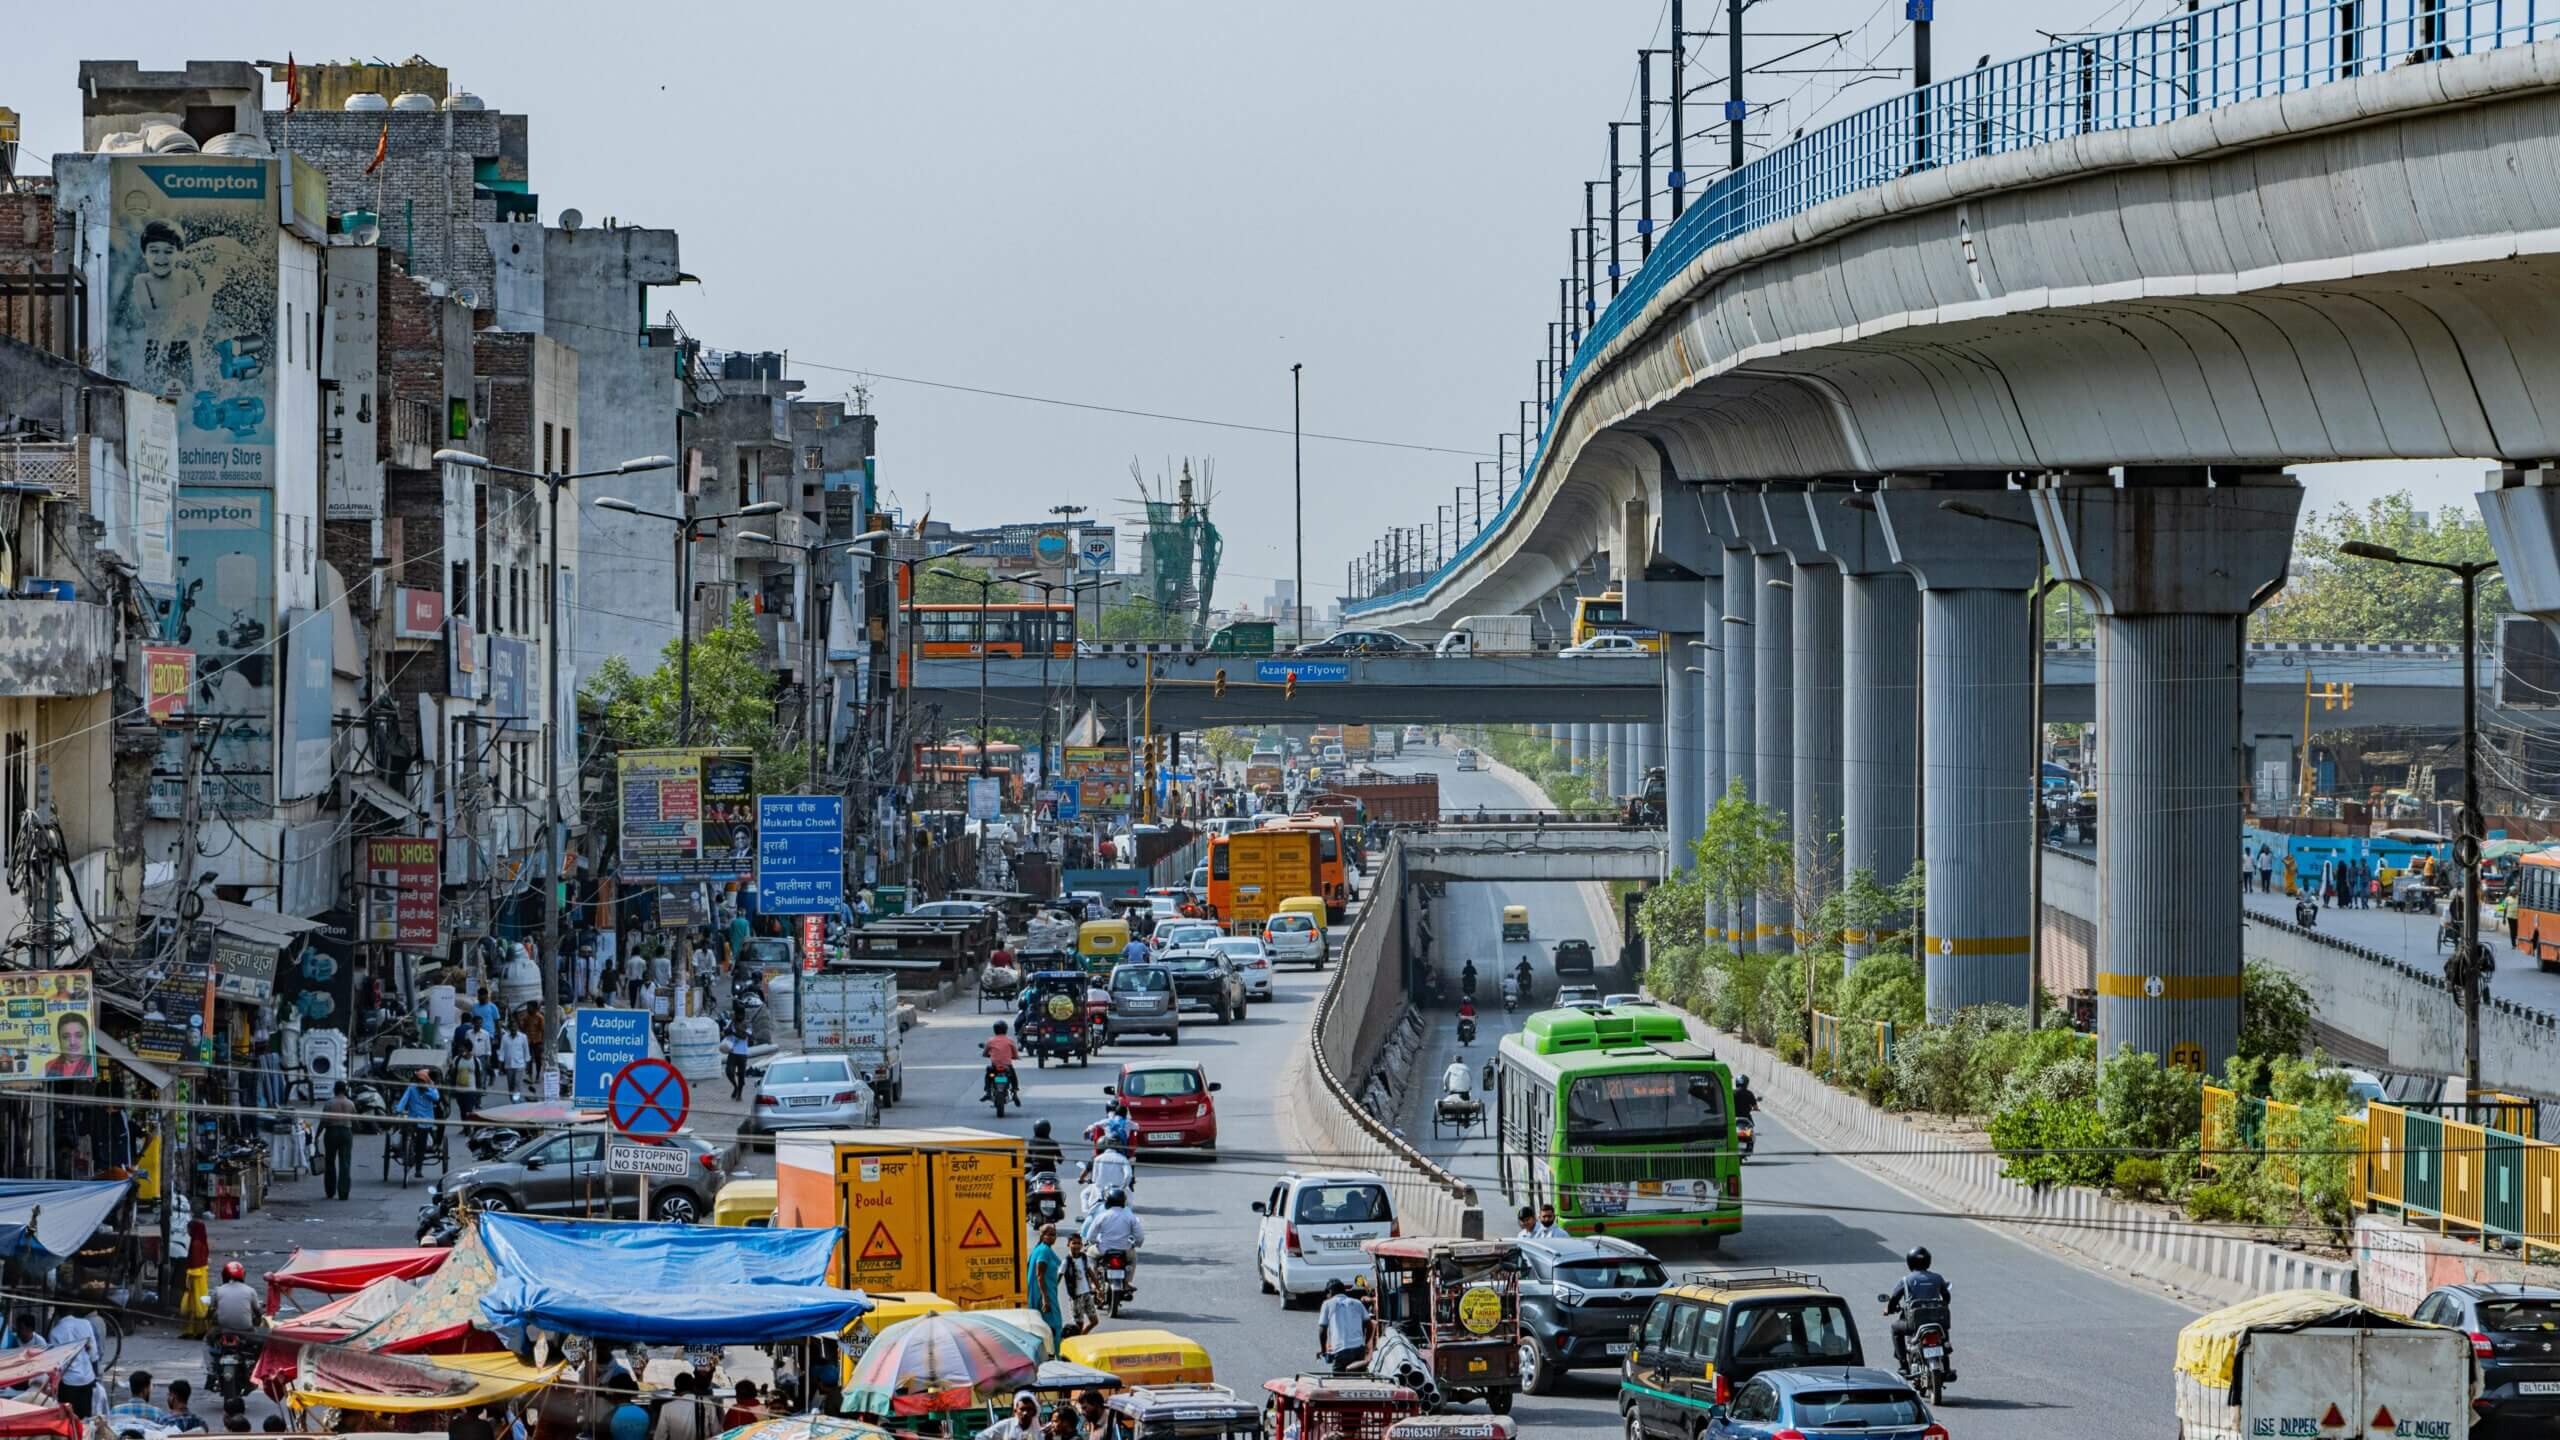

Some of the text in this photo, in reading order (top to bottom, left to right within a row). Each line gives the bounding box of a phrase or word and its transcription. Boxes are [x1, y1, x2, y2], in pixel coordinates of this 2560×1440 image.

[163, 174, 258, 192] Crompton
[232, 448, 262, 465] Store
[328, 503, 374, 511] AGGARWAL
[1090, 543, 1106, 553] HP
[1307, 665, 1346, 676] Flyover
[762, 818, 837, 827] Mukarba Chowk
[371, 844, 434, 864] TONI SHOES
[762, 856, 796, 865] Burari
[775, 895, 841, 906] Shalimar Bagh
[591, 1016, 637, 1030] Azadpur
[580, 1032, 644, 1046] Commercial
[587, 1049, 635, 1063] Complex
[615, 1149, 684, 1162] NO STOPPING
[614, 1160, 683, 1173] NO STANDING
[881, 1162, 908, 1176] मदर
[875, 1241, 884, 1249] N
[850, 1346, 863, 1356] 20
[694, 1355, 707, 1365] 20
[2253, 1417, 2318, 1436] USE DIPPER
[2396, 1419, 2452, 1438] AT NIGHT
